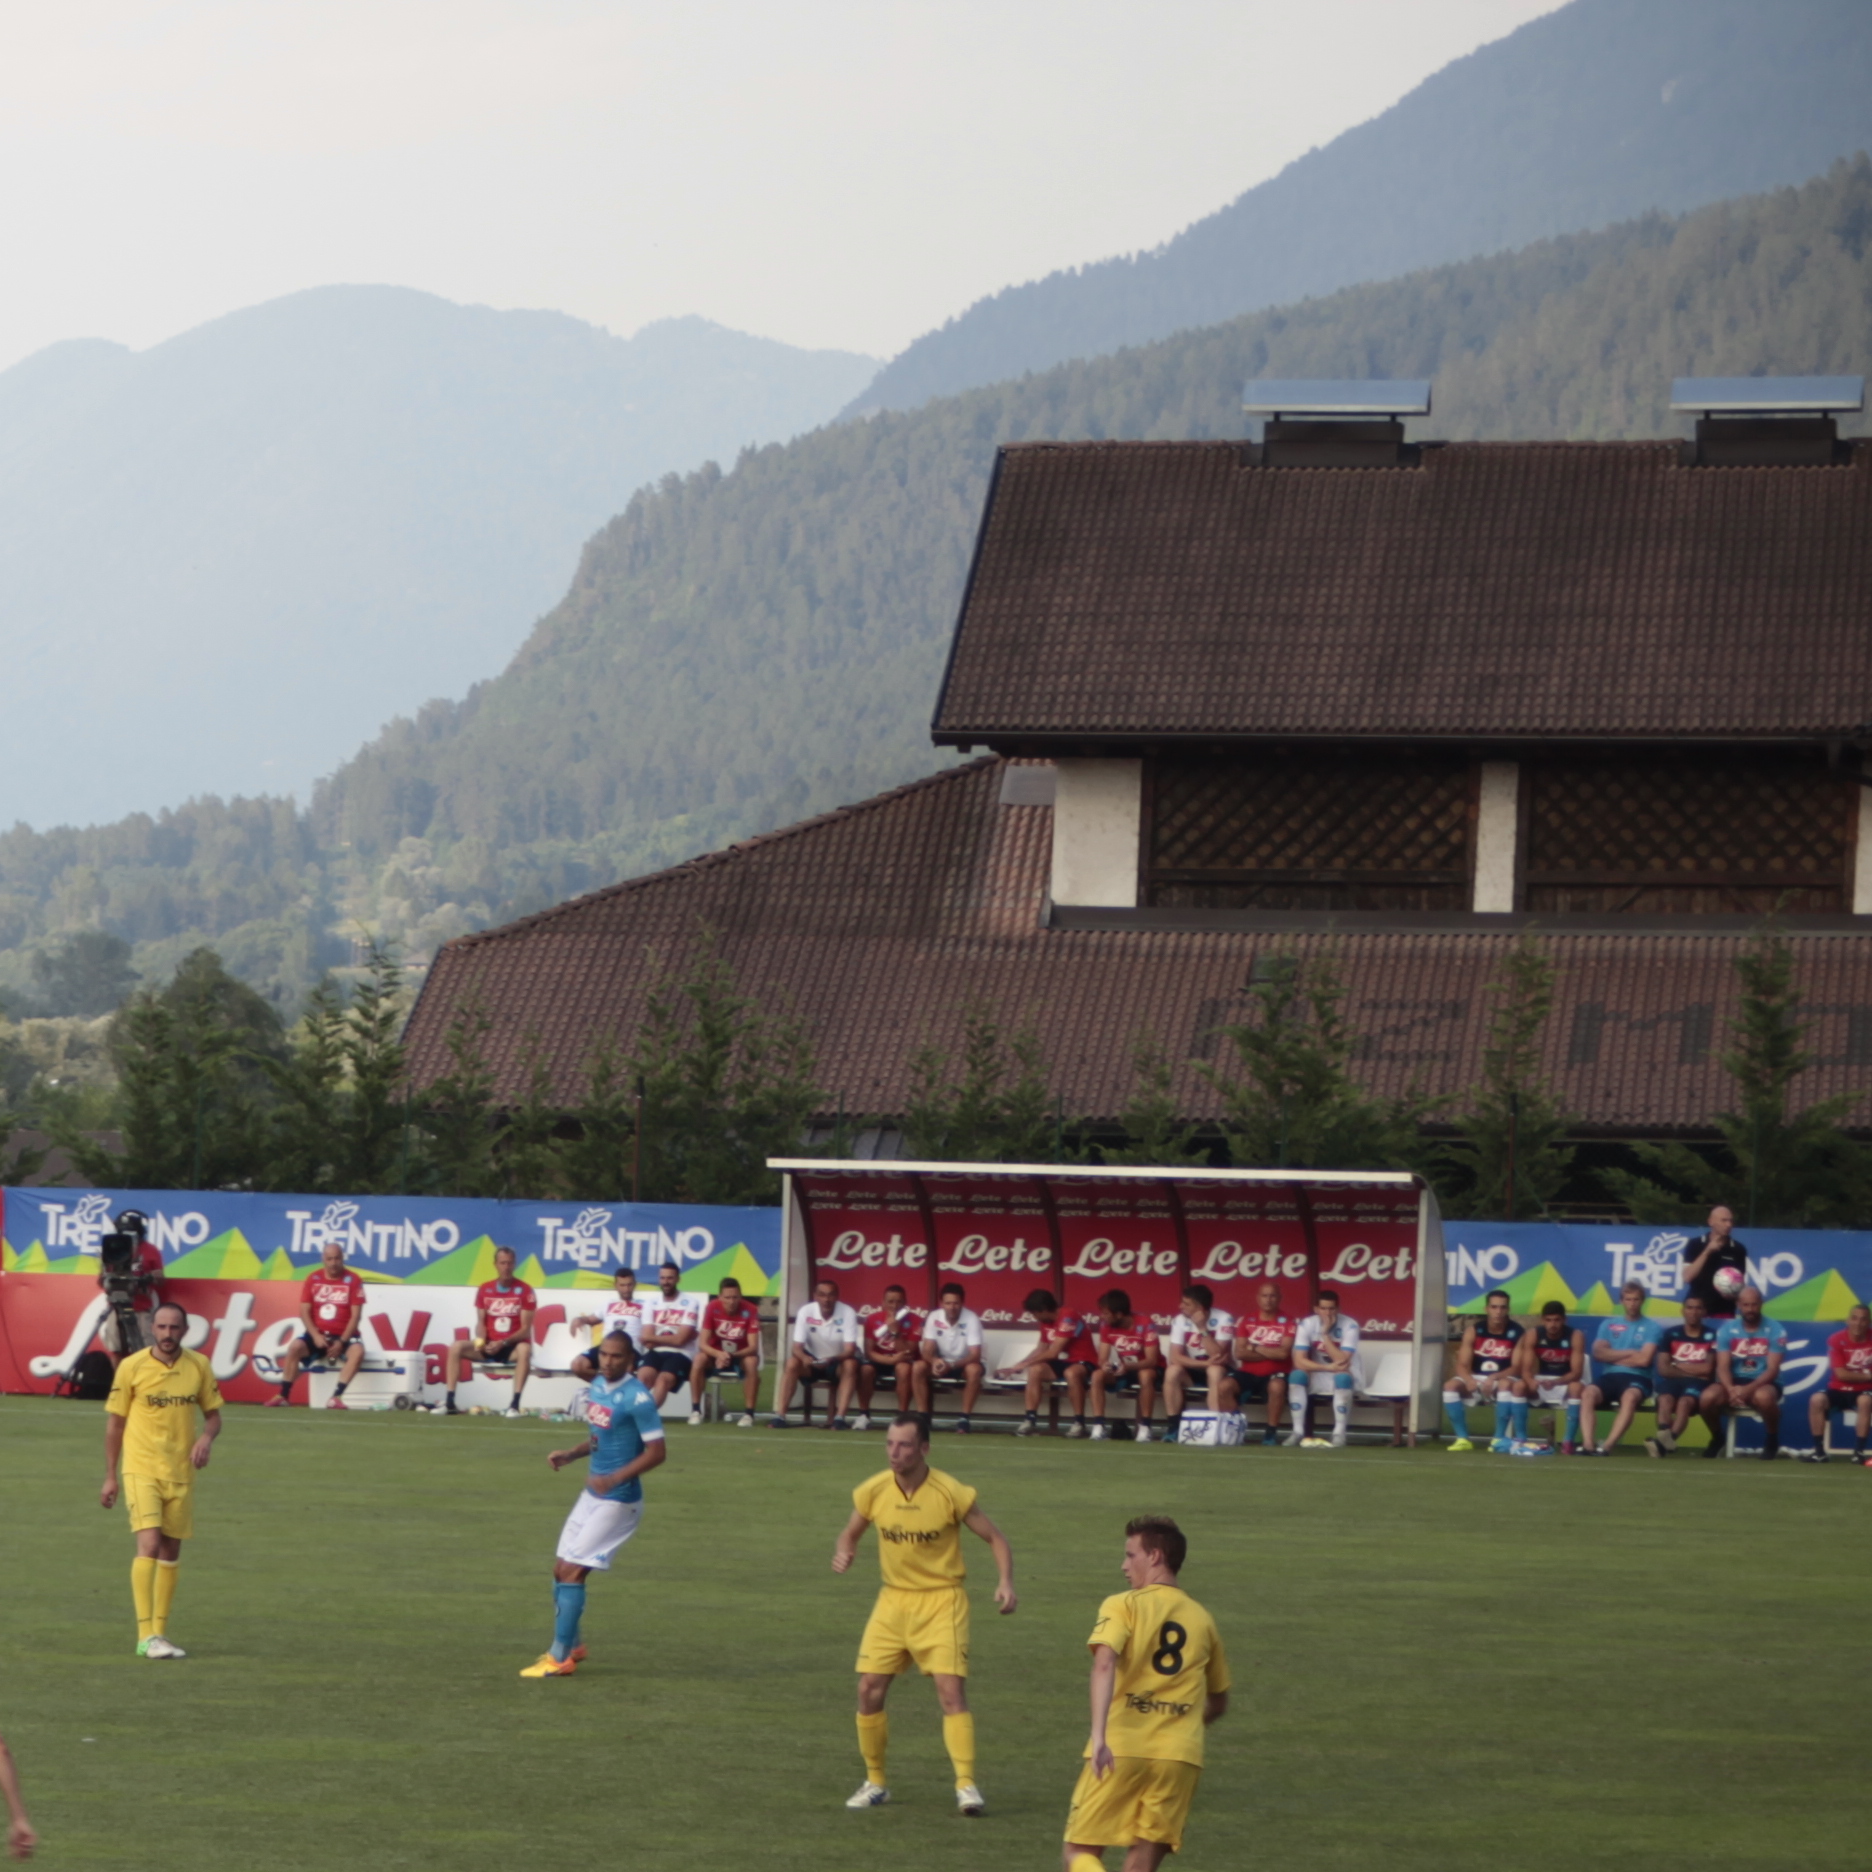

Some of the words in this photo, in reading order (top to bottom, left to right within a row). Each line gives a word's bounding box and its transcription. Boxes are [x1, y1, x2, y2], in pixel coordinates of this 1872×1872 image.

[285, 1208, 460, 1263] TRENTINO
[537, 1216, 715, 1269] TRENTINO
[814, 1230, 928, 1270] Lete
[937, 1234, 1052, 1274] Lete
[1063, 1238, 1179, 1277] Lete
[1190, 1240, 1308, 1280] Lete
[1318, 1243, 1417, 1283] Let
[1362, 1319, 1397, 1332] Lete
[145, 1394, 197, 1408] TRENTINO
[880, 1527, 940, 1545] TRENTINO
[1151, 1619, 1188, 1676] 8
[1124, 1691, 1193, 1716] TRENTINO
